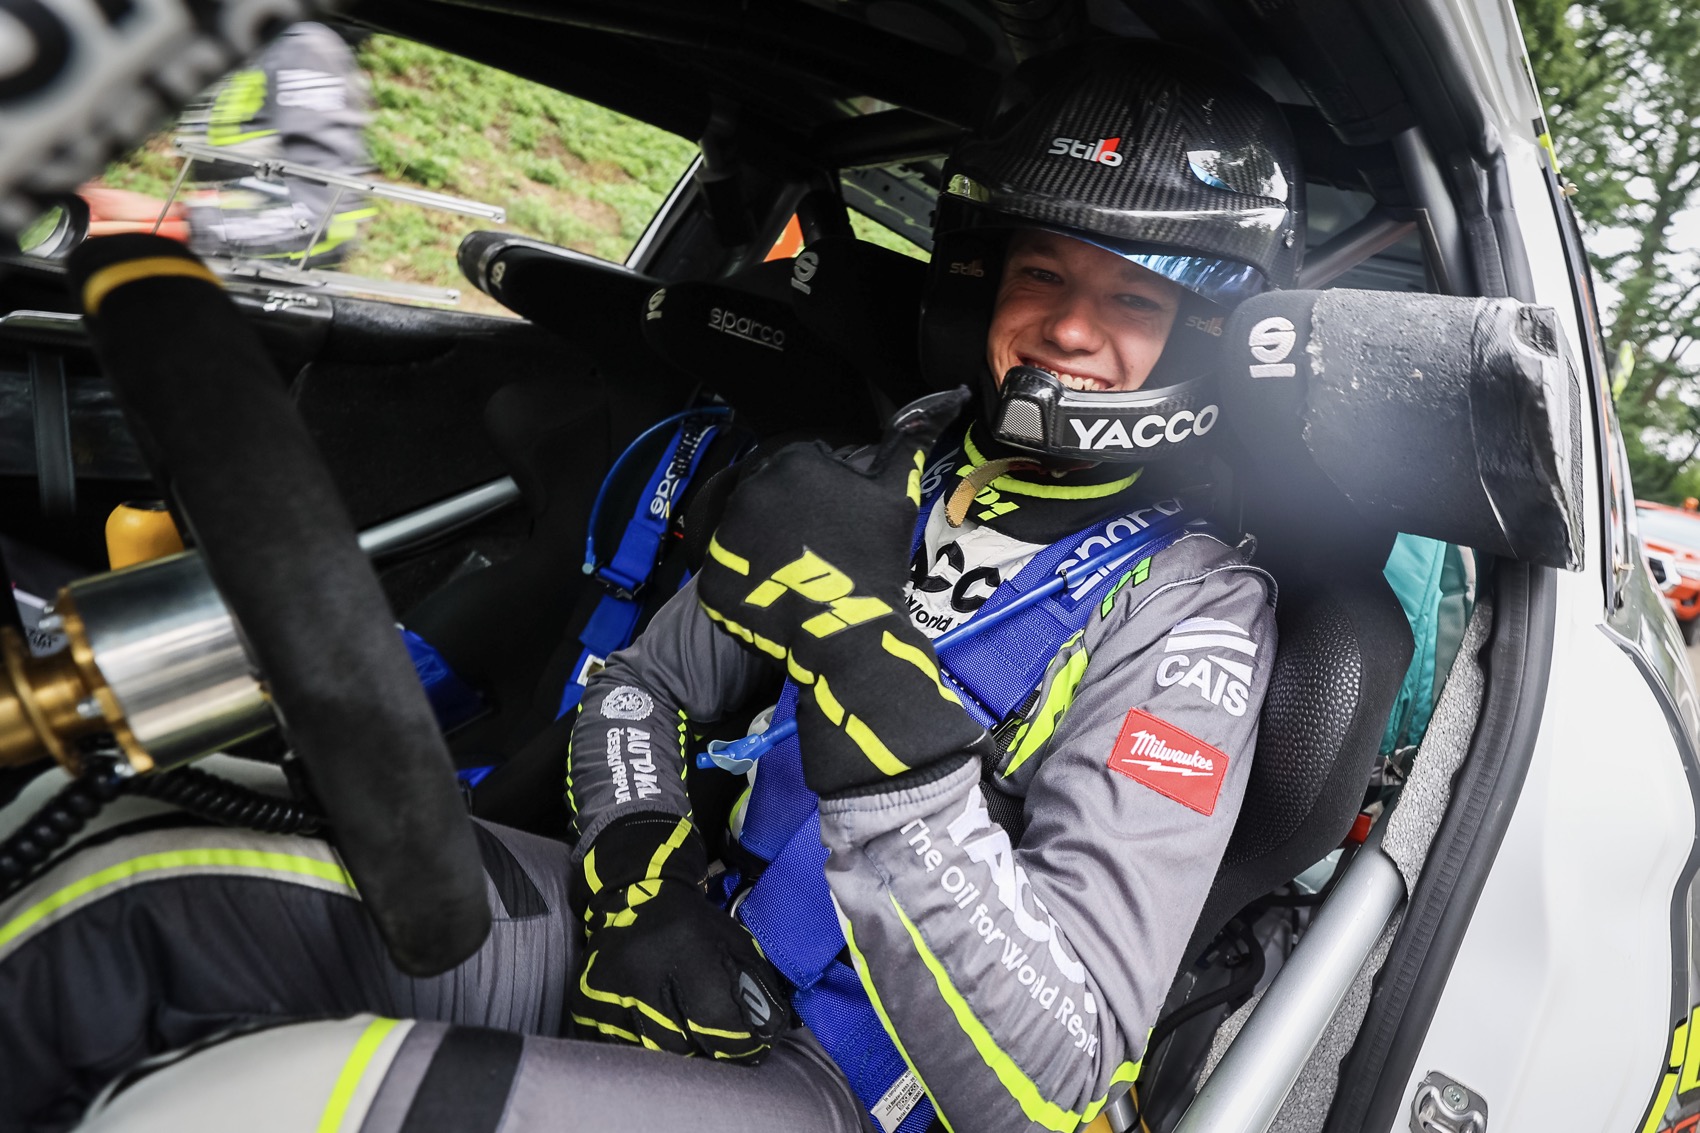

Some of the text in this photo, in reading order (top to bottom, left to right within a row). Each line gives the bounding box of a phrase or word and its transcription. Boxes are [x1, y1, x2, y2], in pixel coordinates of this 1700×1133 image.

[1048, 137, 1123, 167] Stilo
[709, 308, 785, 348] sparco
[1069, 404, 1219, 450] YACCO
[1055, 497, 1183, 588] sparc
[1156, 654, 1249, 717] CAIS
[1130, 730, 1214, 771] Milwaukee
[900, 818, 943, 873] The
[940, 865, 981, 909] Oil
[968, 903, 1005, 945] for
[946, 783, 1098, 1014] YACC
